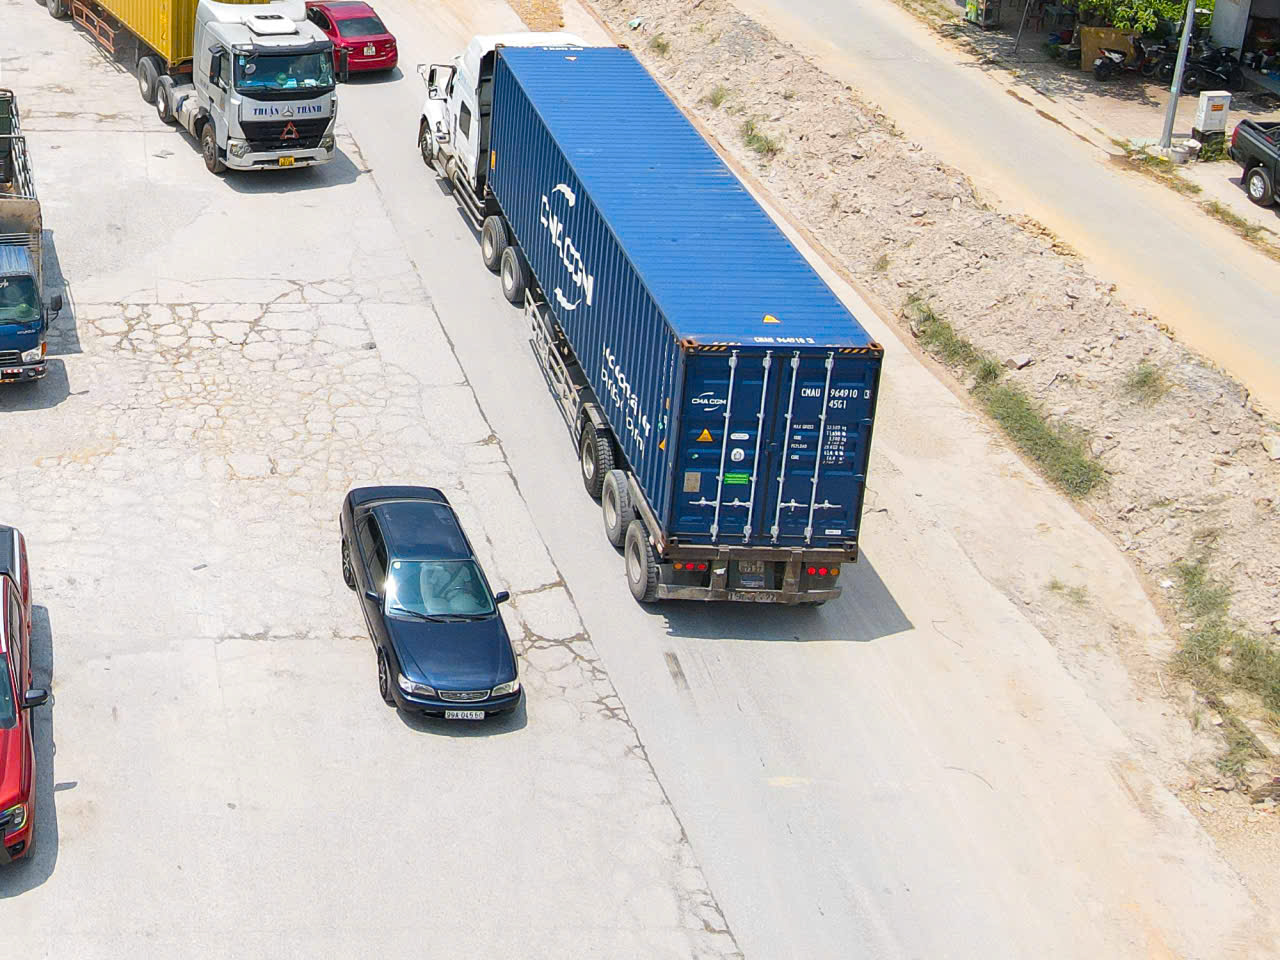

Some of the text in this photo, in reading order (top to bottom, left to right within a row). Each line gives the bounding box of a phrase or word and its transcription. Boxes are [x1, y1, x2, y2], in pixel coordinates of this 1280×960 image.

[801, 388, 821, 397] CMAU
[830, 389, 858, 399] 964910
[828, 400, 847, 409] 45G1
